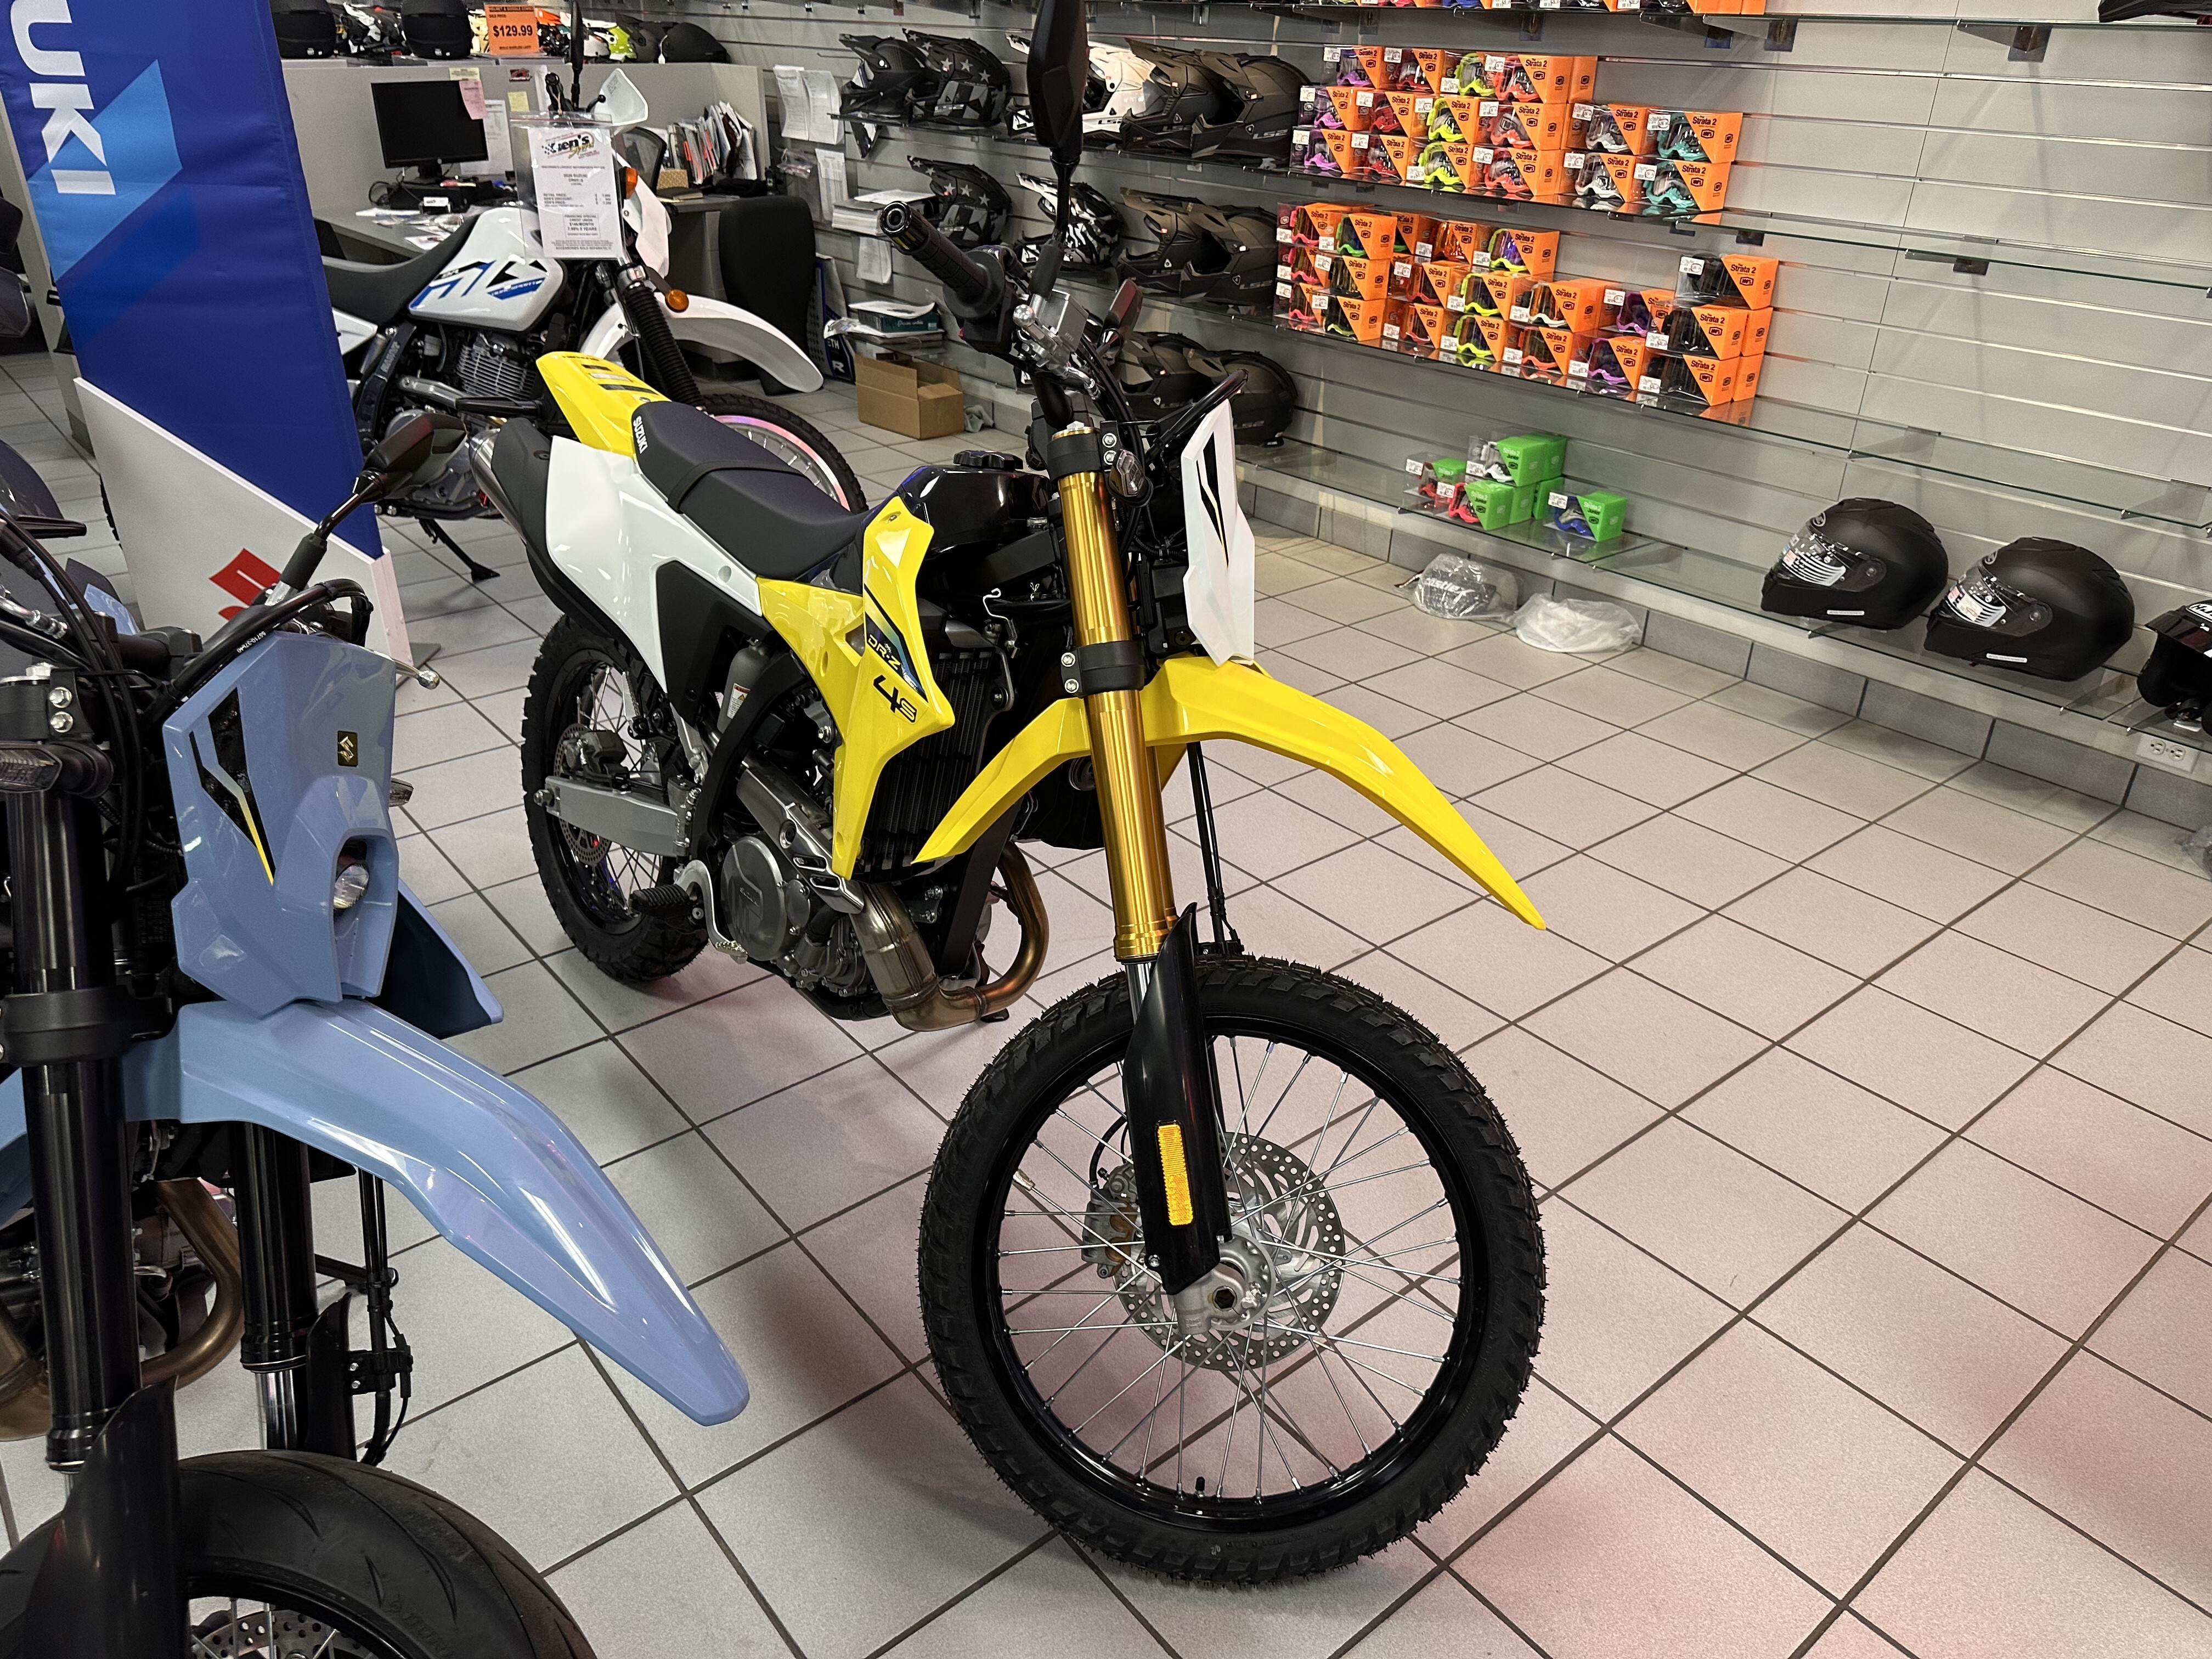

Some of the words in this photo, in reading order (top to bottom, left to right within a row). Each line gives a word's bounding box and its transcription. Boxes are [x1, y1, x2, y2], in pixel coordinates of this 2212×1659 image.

[493, 25, 533, 38] $129.99
[1692, 117, 1711, 125] Strata
[1252, 129, 1288, 139] LS2
[1516, 153, 1532, 161] Strata
[1682, 165, 1700, 174] Strata
[1730, 264, 1751, 273] Strata
[1556, 289, 1572, 297] Strata
[1700, 314, 1719, 323] Strata
[1546, 332, 1562, 341] Strata
[1616, 346, 1633, 354] Strata
[1691, 360, 1709, 369] Strata
[633, 416, 648, 454] SUZUKI
[868, 634, 900, 670] DR-Z
[873, 674, 917, 723] 4S
